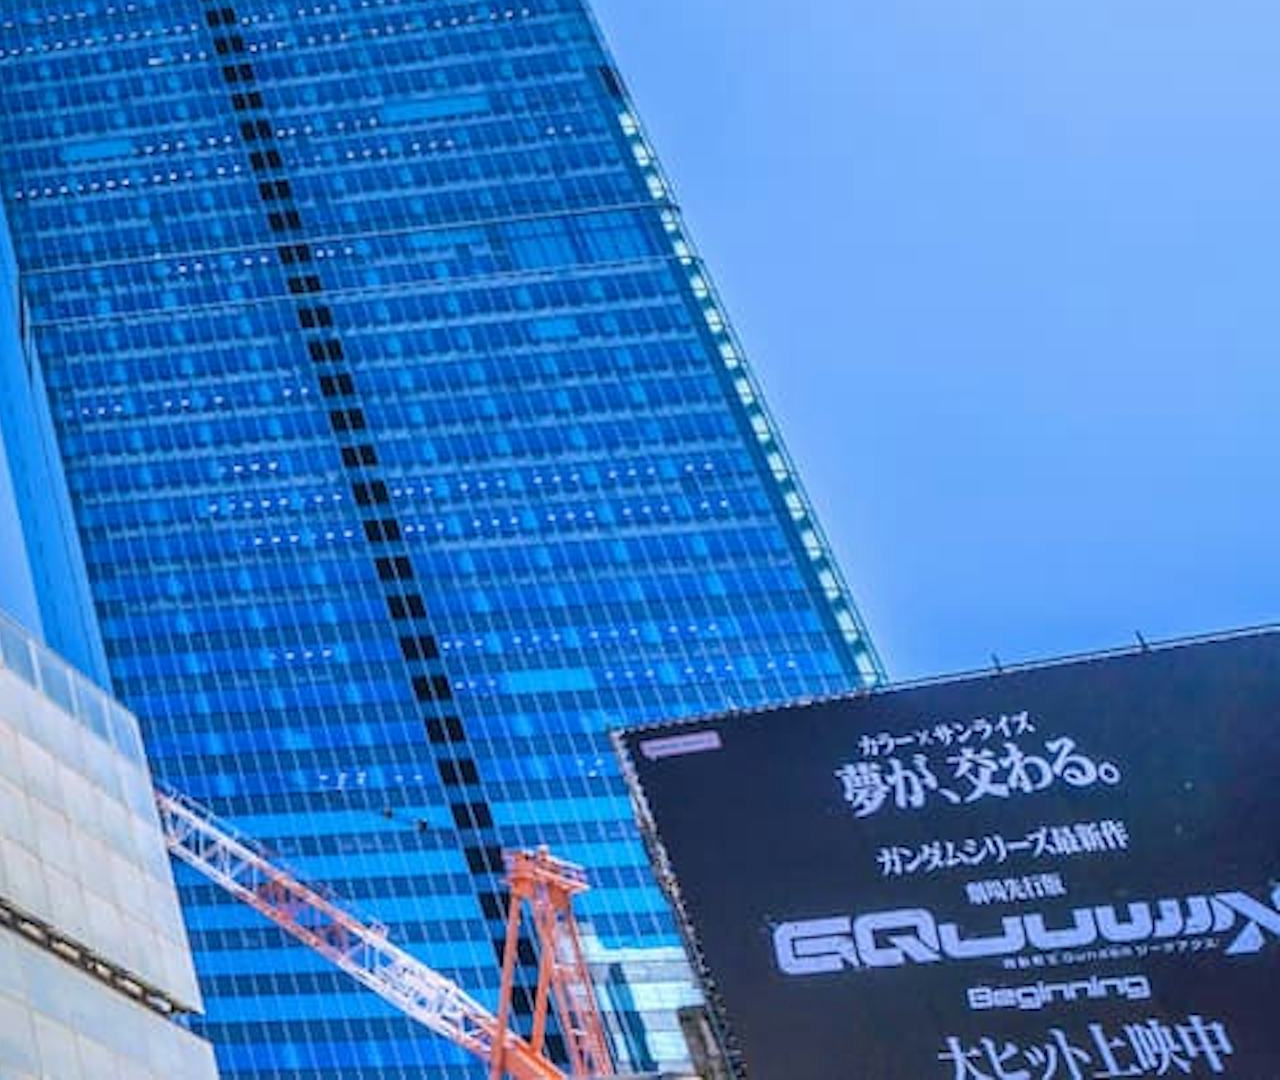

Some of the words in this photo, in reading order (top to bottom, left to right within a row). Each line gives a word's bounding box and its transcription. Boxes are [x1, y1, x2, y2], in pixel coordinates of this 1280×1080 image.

[834, 736, 1122, 818] 夢が、交わる。
[876, 820, 1130, 876] ガンダムシリーズ最新作
[966, 974, 1152, 1010] Beginning
[937, 1014, 1234, 1080] 大ヒット上映中
